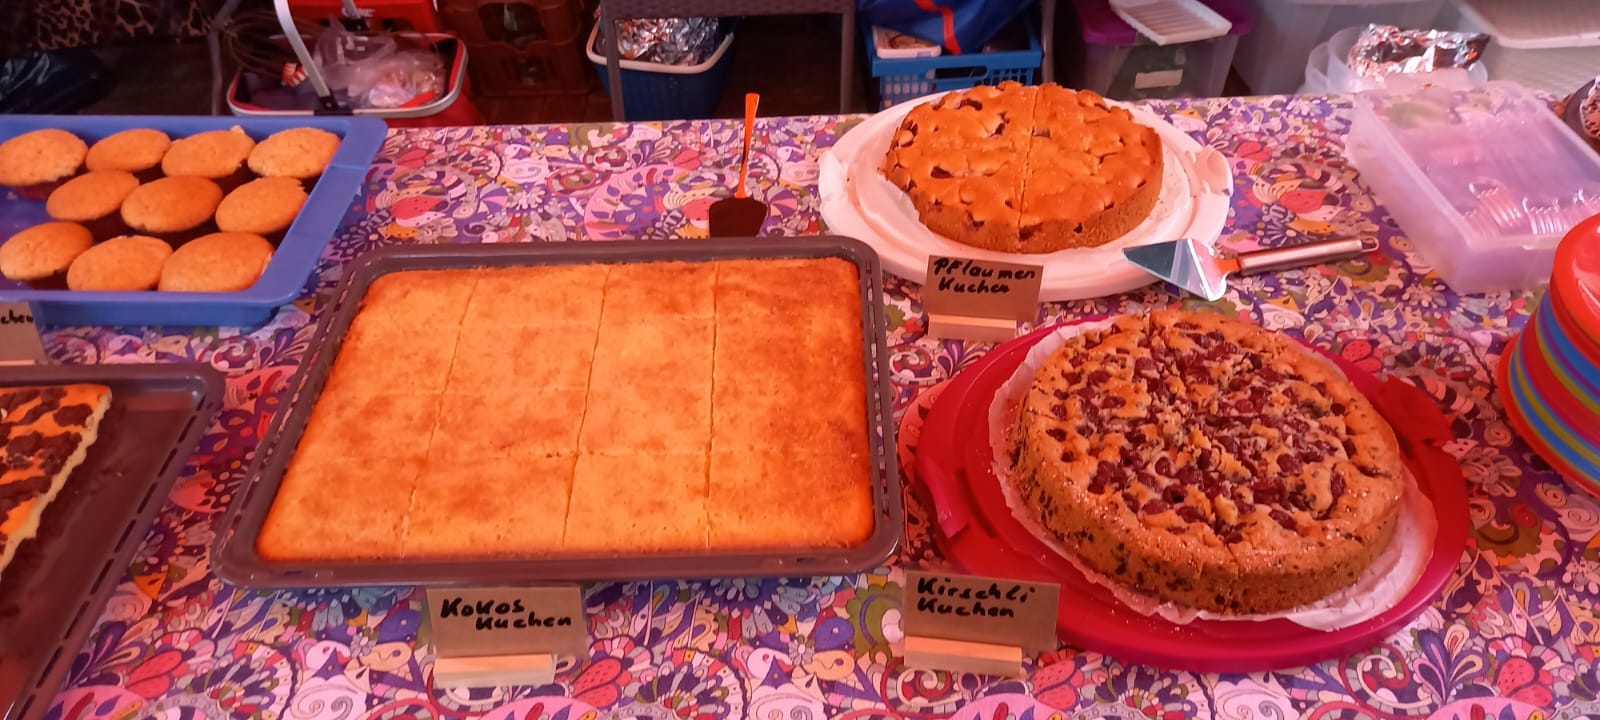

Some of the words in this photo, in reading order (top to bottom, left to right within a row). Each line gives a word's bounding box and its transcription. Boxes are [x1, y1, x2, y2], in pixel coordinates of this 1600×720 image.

[938, 277, 1010, 294] Kuchen
[917, 577, 1035, 603] Kirschli
[917, 597, 1015, 618] Kuchen
